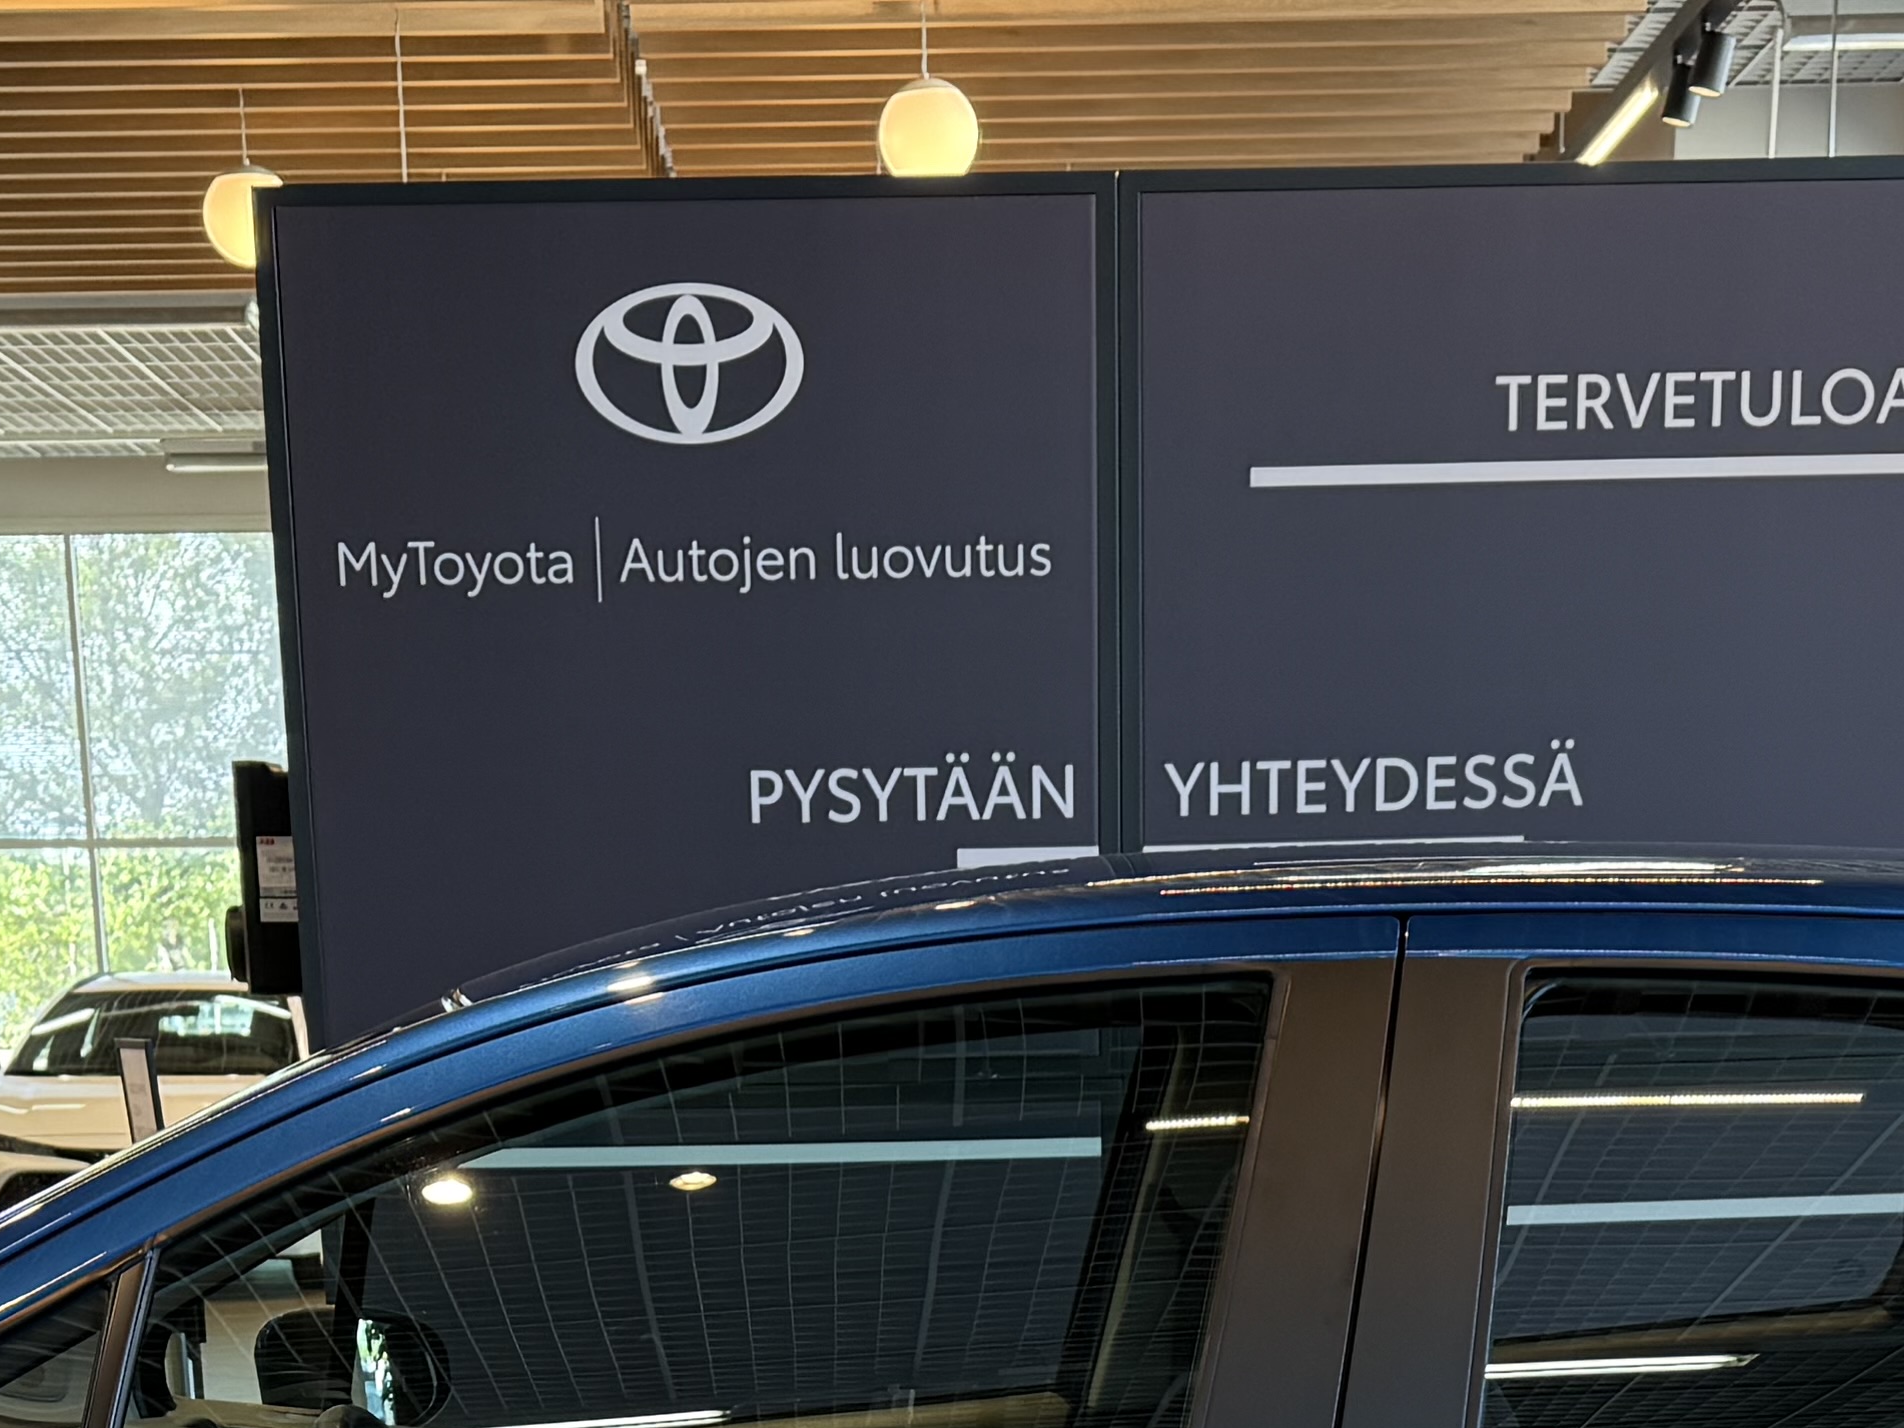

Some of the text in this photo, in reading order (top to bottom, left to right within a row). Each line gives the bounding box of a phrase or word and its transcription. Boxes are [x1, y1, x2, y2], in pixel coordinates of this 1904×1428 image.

[337, 532, 1052, 599] MyToyota Autojen luovutus
[749, 738, 1583, 825] PYSYTÄÄN YHTEYDESSÄ
